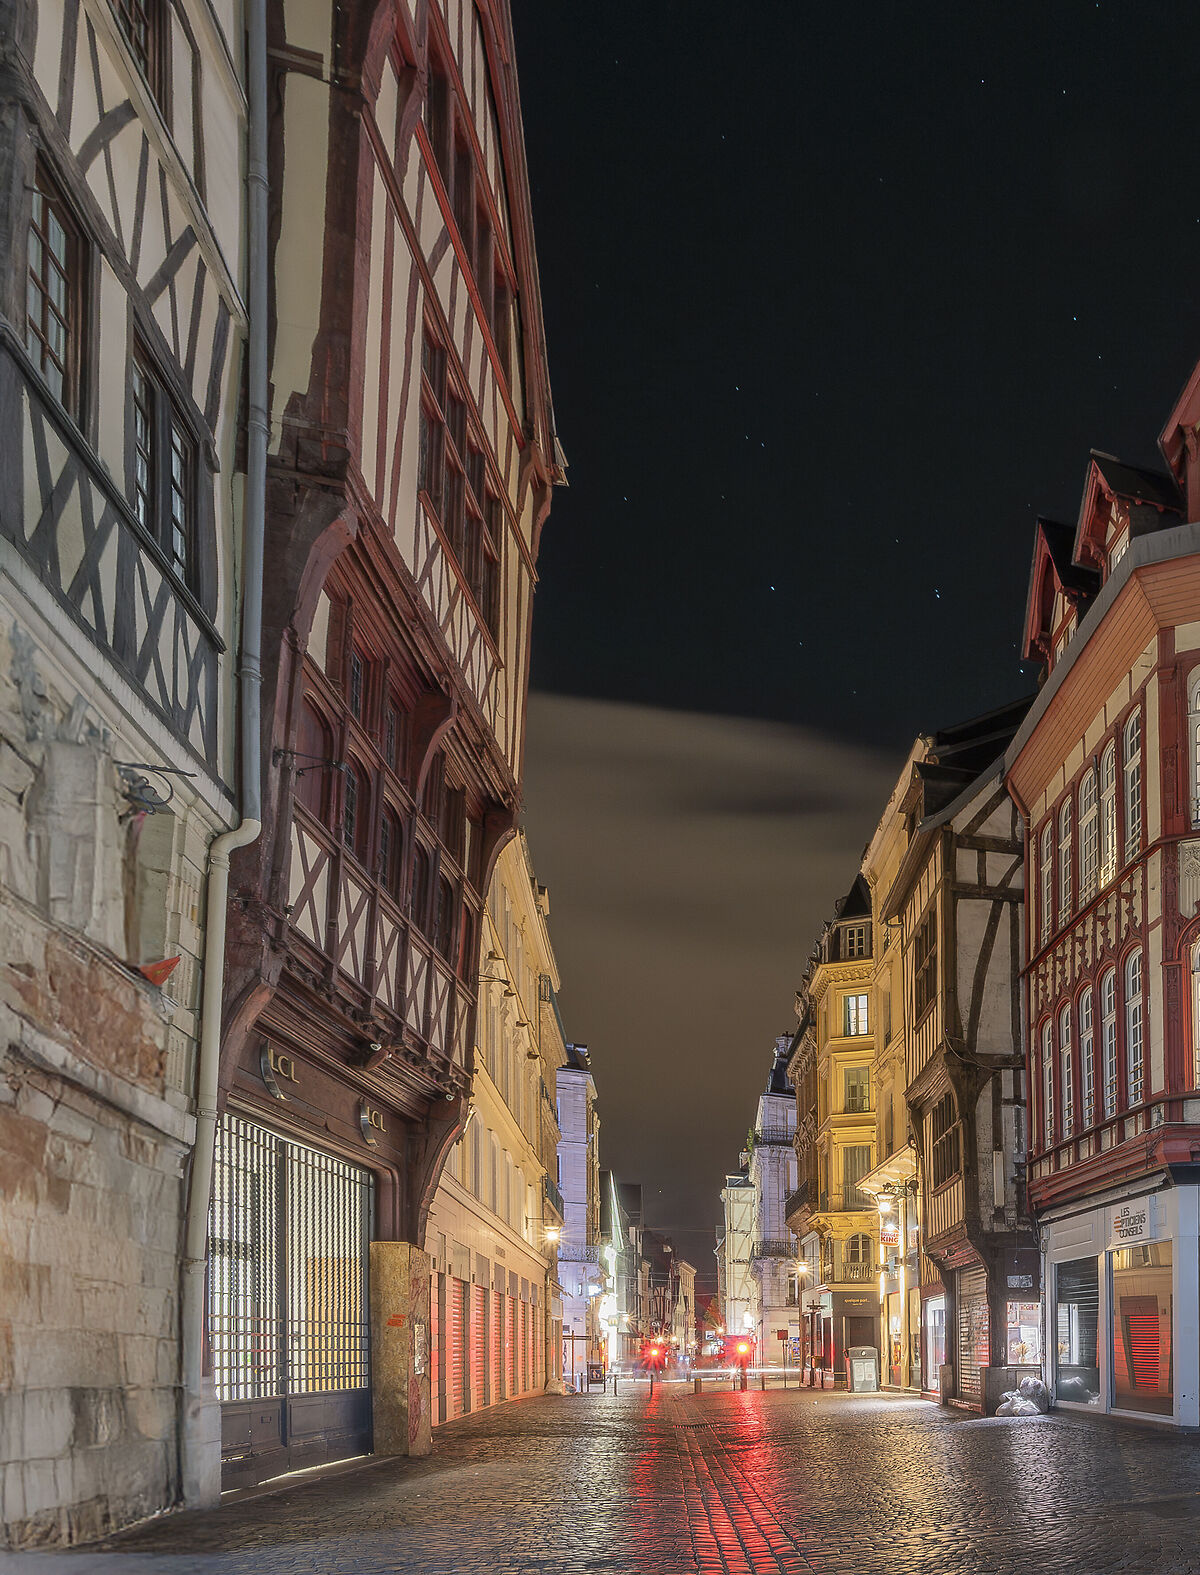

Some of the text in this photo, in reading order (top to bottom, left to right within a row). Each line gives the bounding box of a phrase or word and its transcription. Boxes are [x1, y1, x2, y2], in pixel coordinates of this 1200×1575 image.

[268, 1048, 300, 1084] LCL
[366, 1106, 387, 1132] LCL
[1120, 1207, 1130, 1218] LES
[1119, 1225, 1143, 1238] CONSEILS
